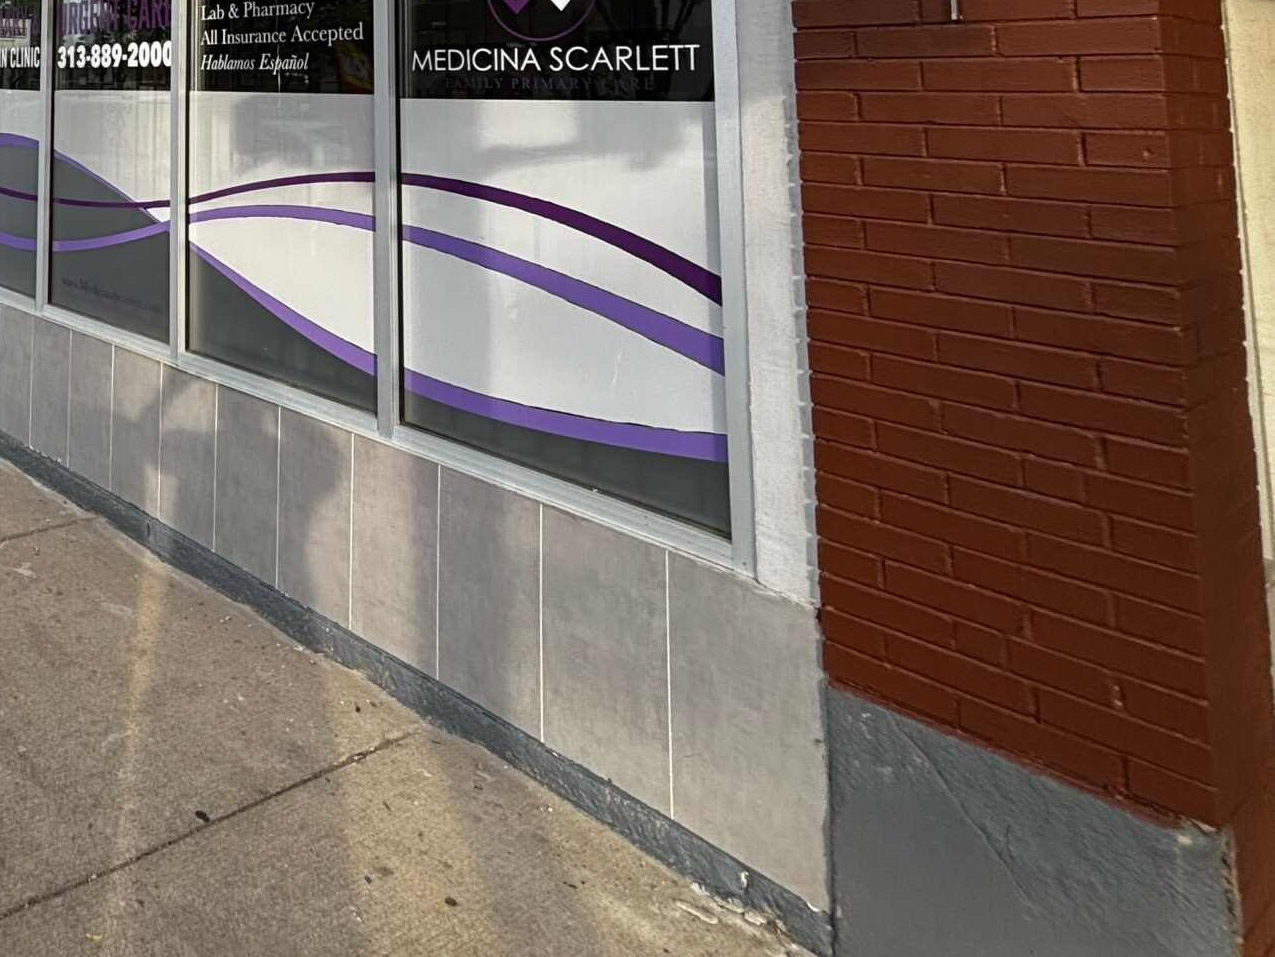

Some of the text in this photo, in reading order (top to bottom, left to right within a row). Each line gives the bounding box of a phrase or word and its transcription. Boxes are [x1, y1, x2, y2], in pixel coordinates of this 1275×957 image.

[201, 1, 315, 21] Lab & Pharmacy
[200, 21, 364, 47] All Insurance Accepted
[10, 46, 40, 69] CLINIC
[57, 40, 172, 69] 313-889-2000
[200, 52, 310, 76] Hablamos Español
[411, 44, 700, 72] MEDICINA SCARLETT
[444, 77, 503, 90] FAMILY
[511, 76, 594, 91] PRIMARY
